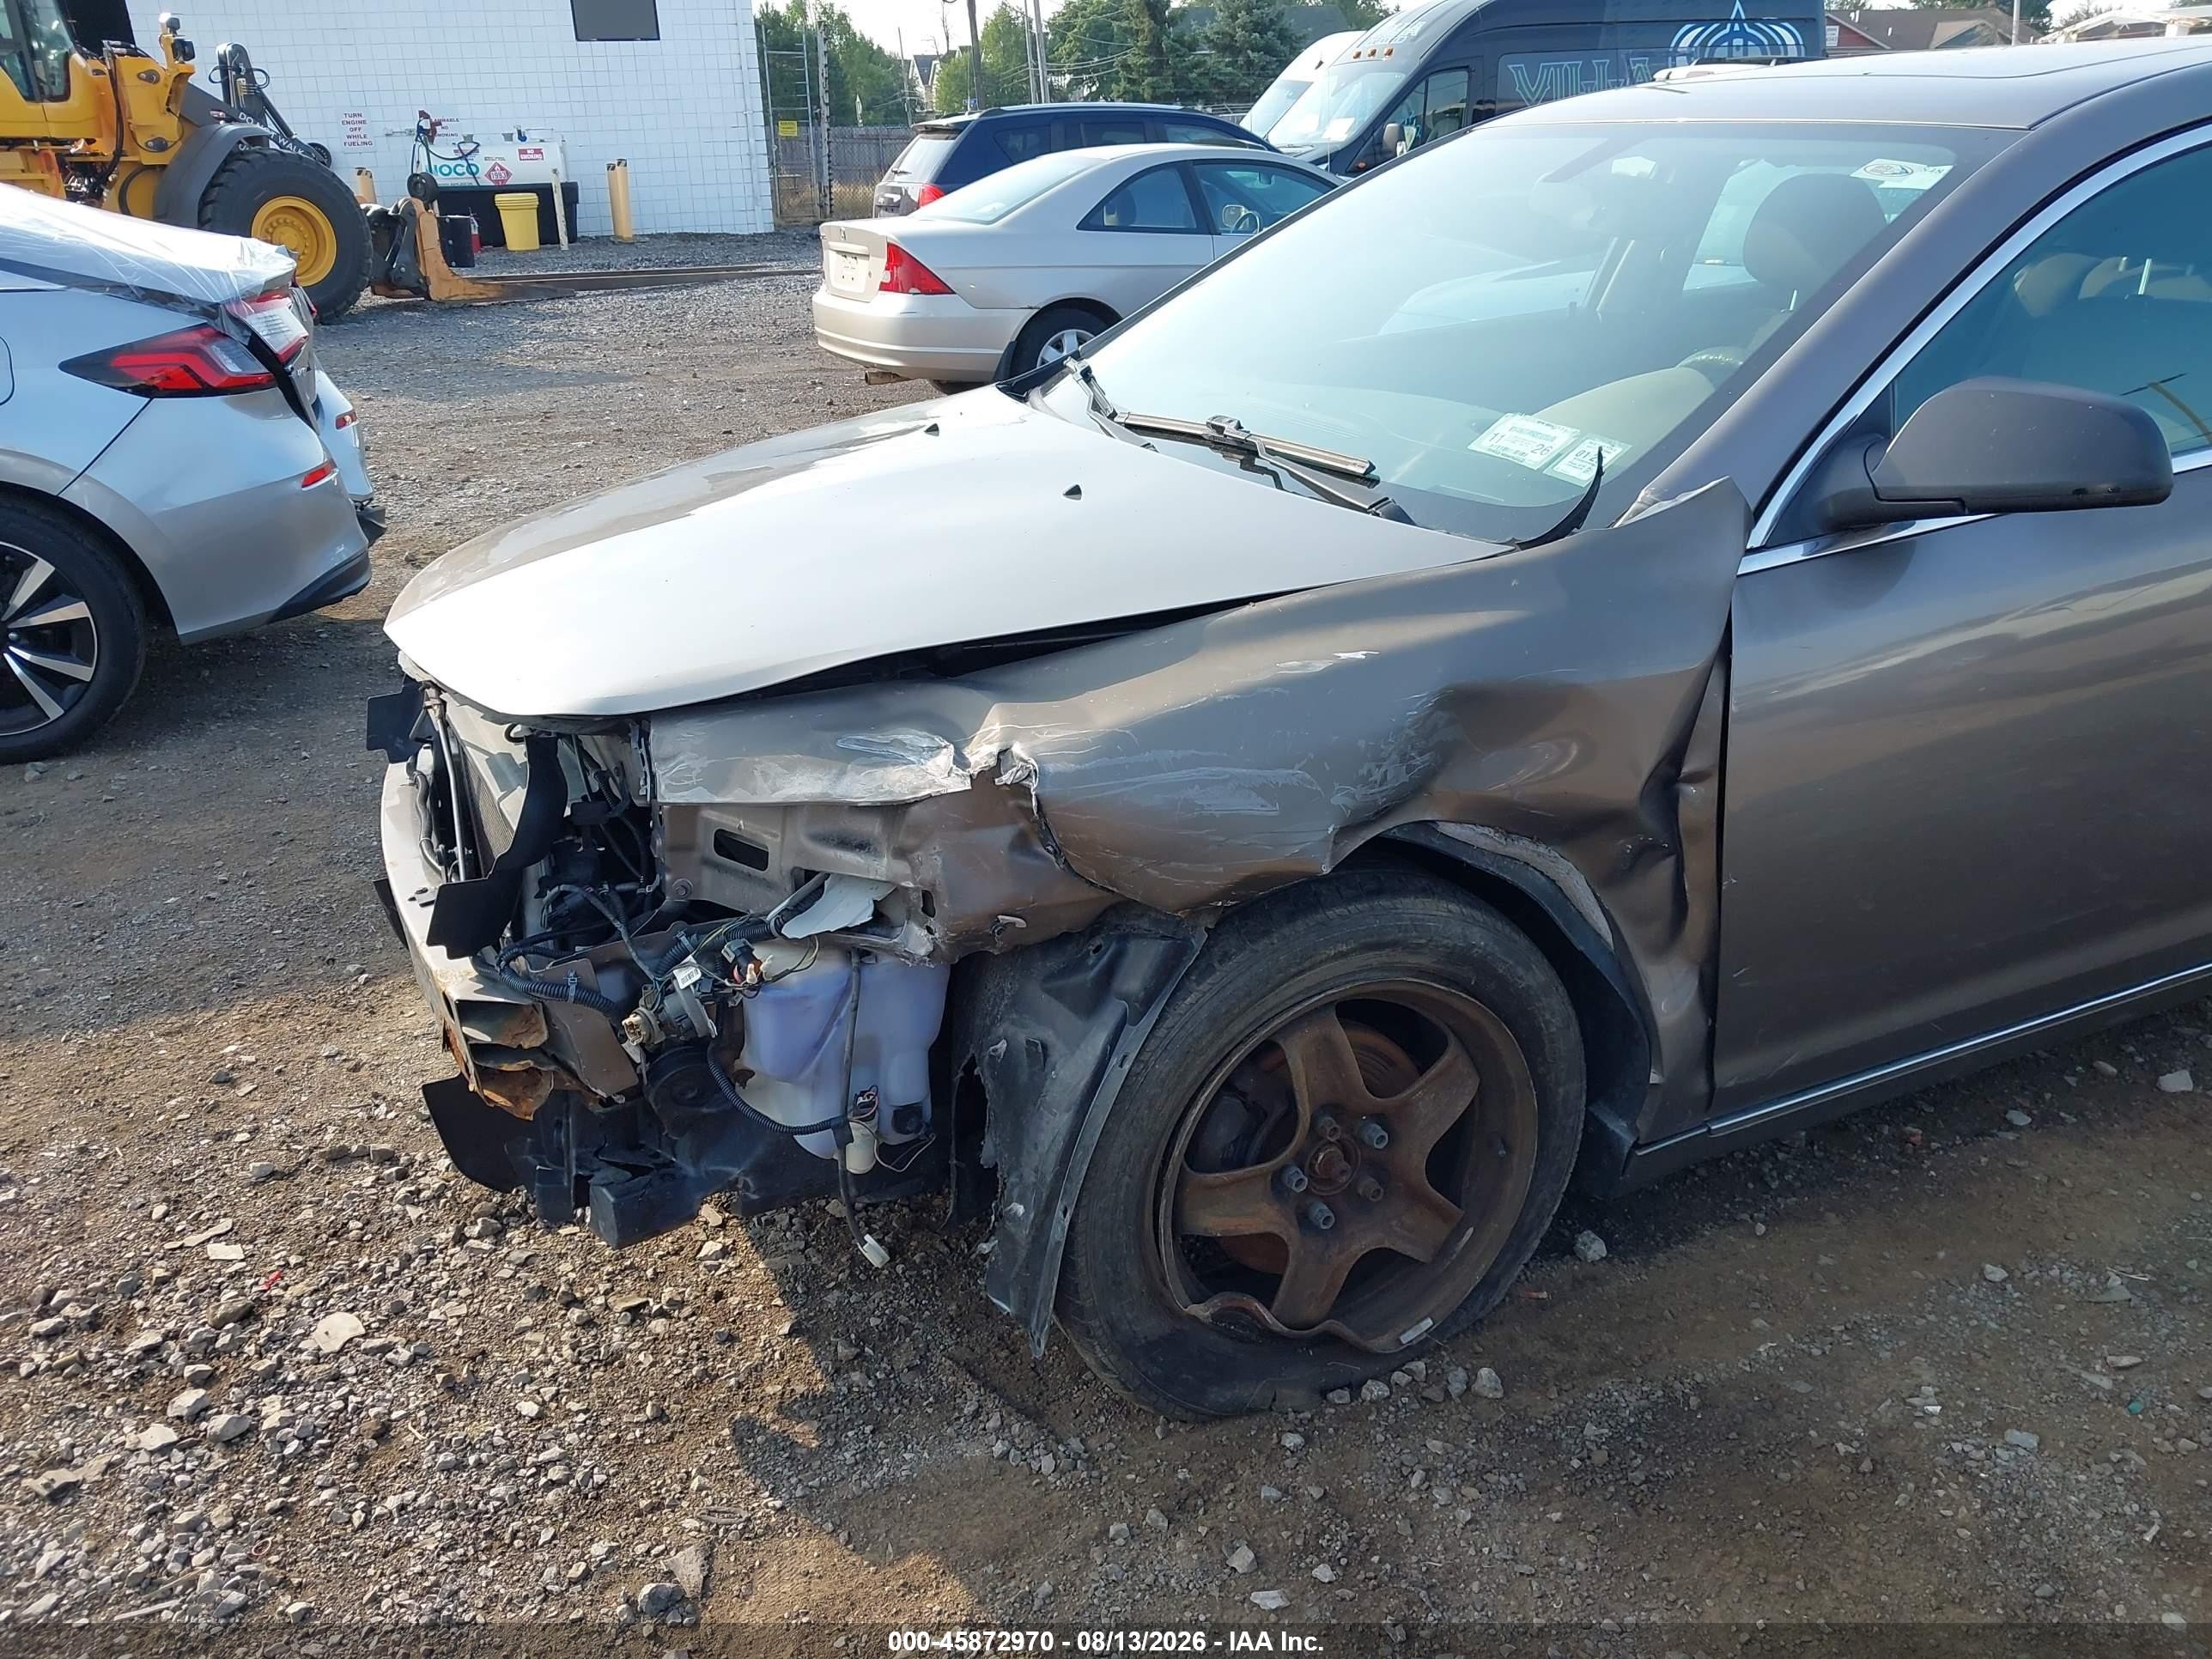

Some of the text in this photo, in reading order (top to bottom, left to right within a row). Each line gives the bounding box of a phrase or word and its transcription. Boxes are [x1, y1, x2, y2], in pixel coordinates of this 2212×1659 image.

[239, 112, 253, 125] DO
[278, 135, 304, 155] WALK
[1530, 443, 1553, 456] 26
